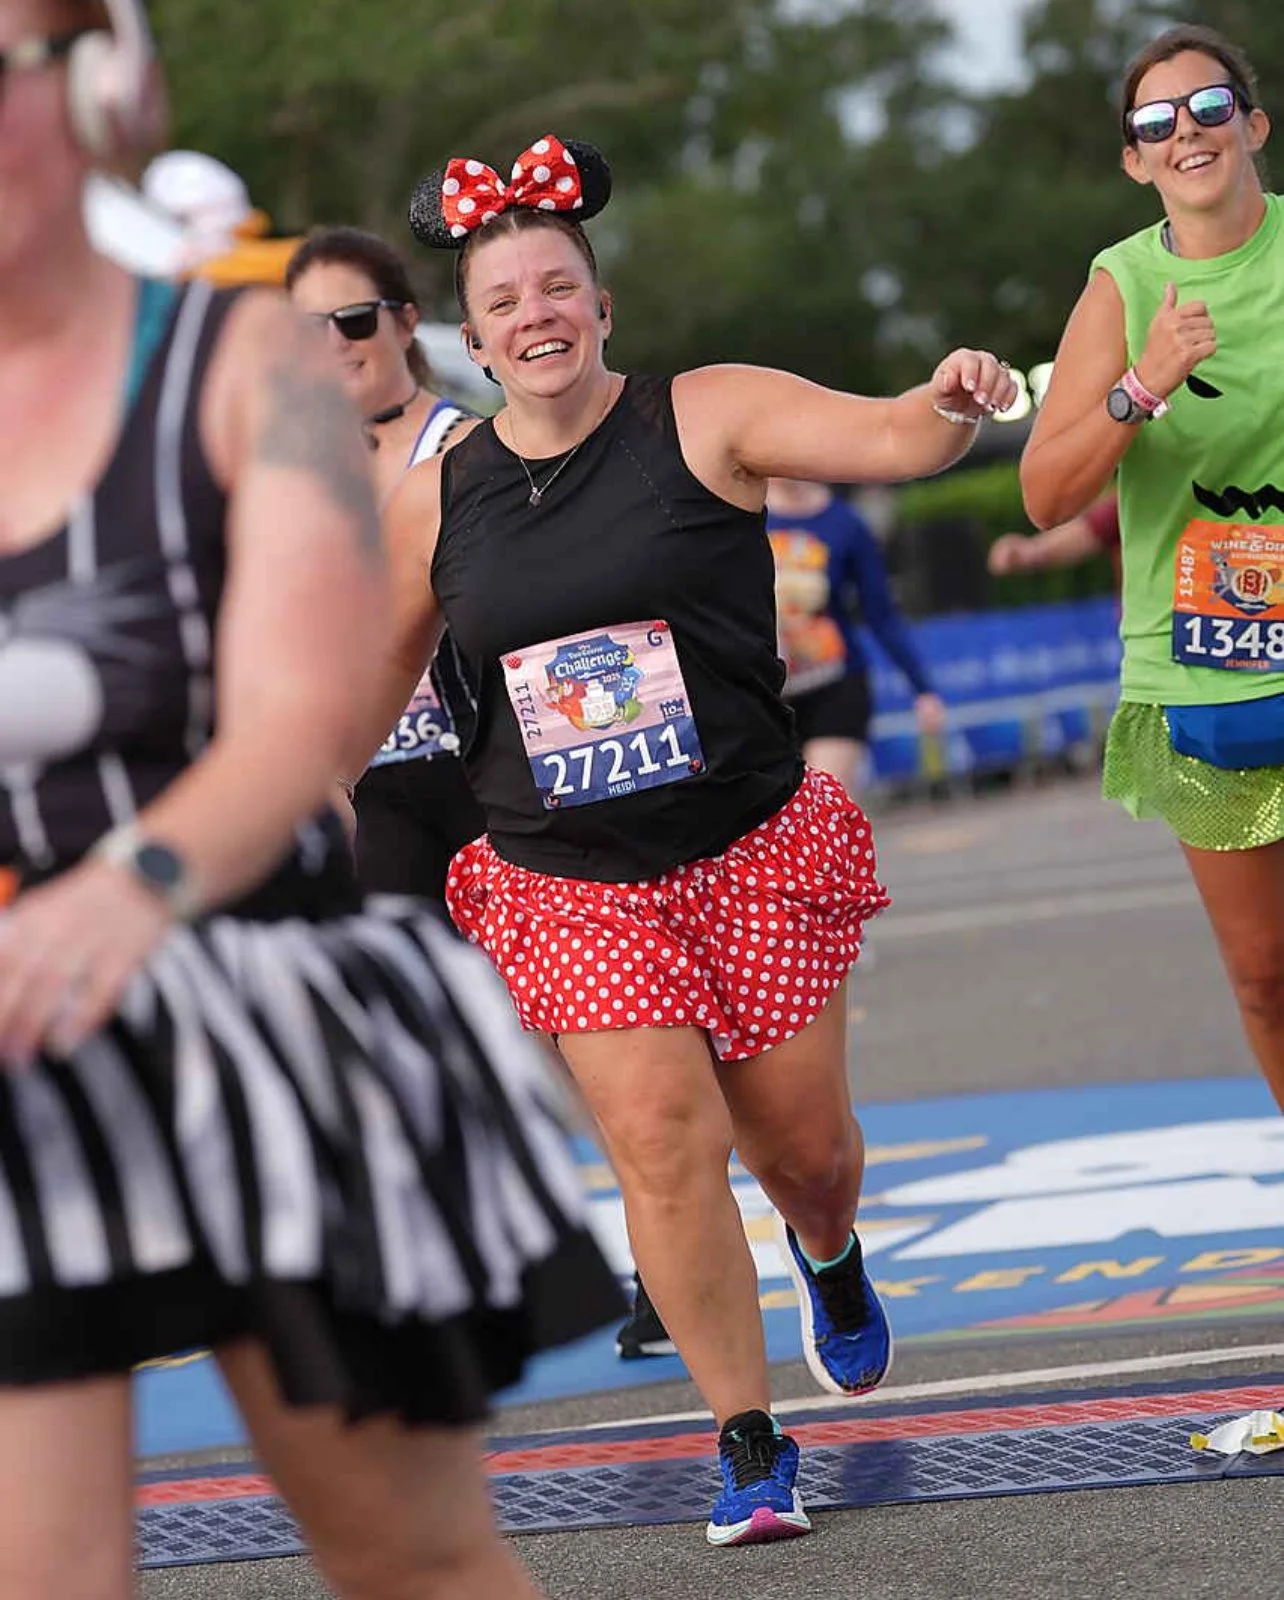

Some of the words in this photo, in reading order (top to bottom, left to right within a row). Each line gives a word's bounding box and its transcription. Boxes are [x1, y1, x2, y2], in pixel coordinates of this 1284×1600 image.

[1179, 543, 1196, 598] 13487
[647, 629, 662, 647] G
[555, 650, 621, 677] Challenge
[514, 682, 542, 740] 27211
[543, 724, 690, 796] 27211
[608, 780, 636, 796] HEIDI
